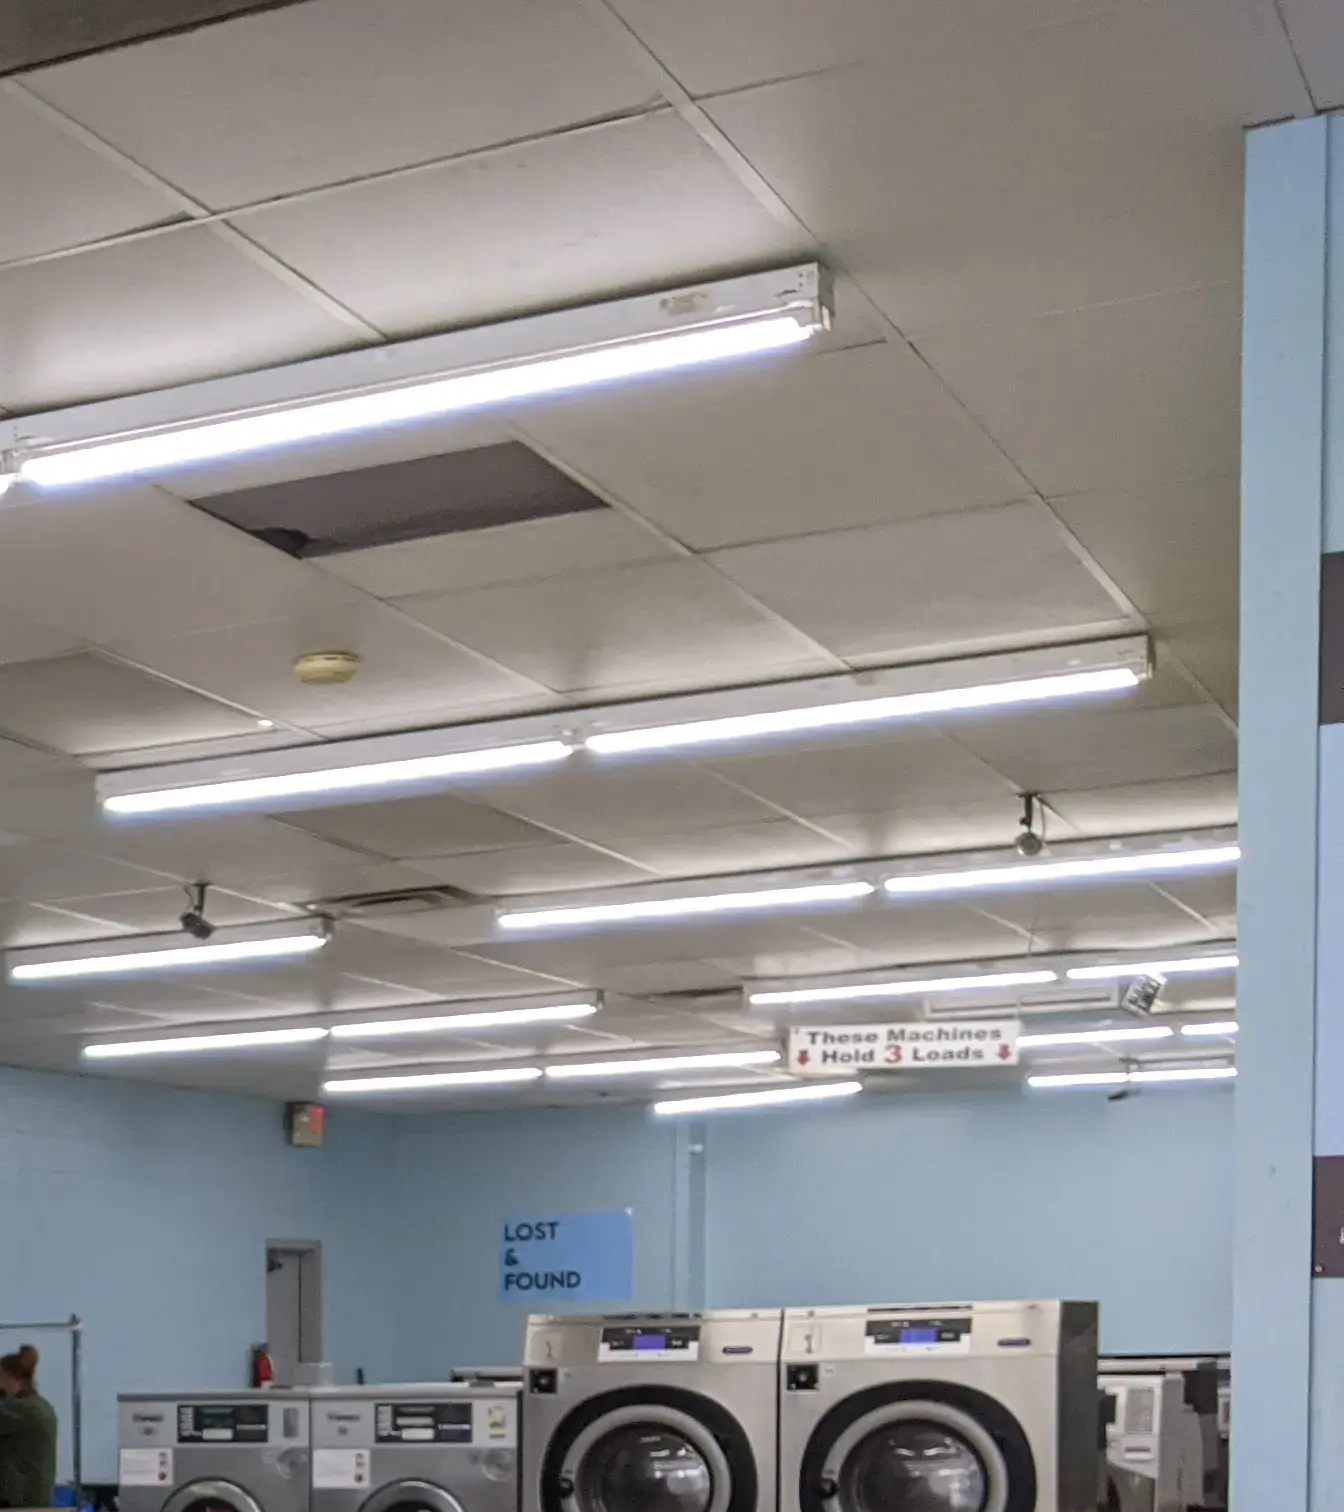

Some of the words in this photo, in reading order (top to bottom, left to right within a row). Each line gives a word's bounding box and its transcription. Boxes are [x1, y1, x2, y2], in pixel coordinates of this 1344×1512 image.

[806, 1030, 879, 1045] These
[886, 1026, 1002, 1043] Machines
[821, 1048, 875, 1064] Hold
[884, 1044, 903, 1064] 3
[912, 1046, 984, 1062] Loads
[504, 1222, 558, 1241] LOST
[505, 1249, 519, 1266] &
[504, 1271, 581, 1291] FOUND
